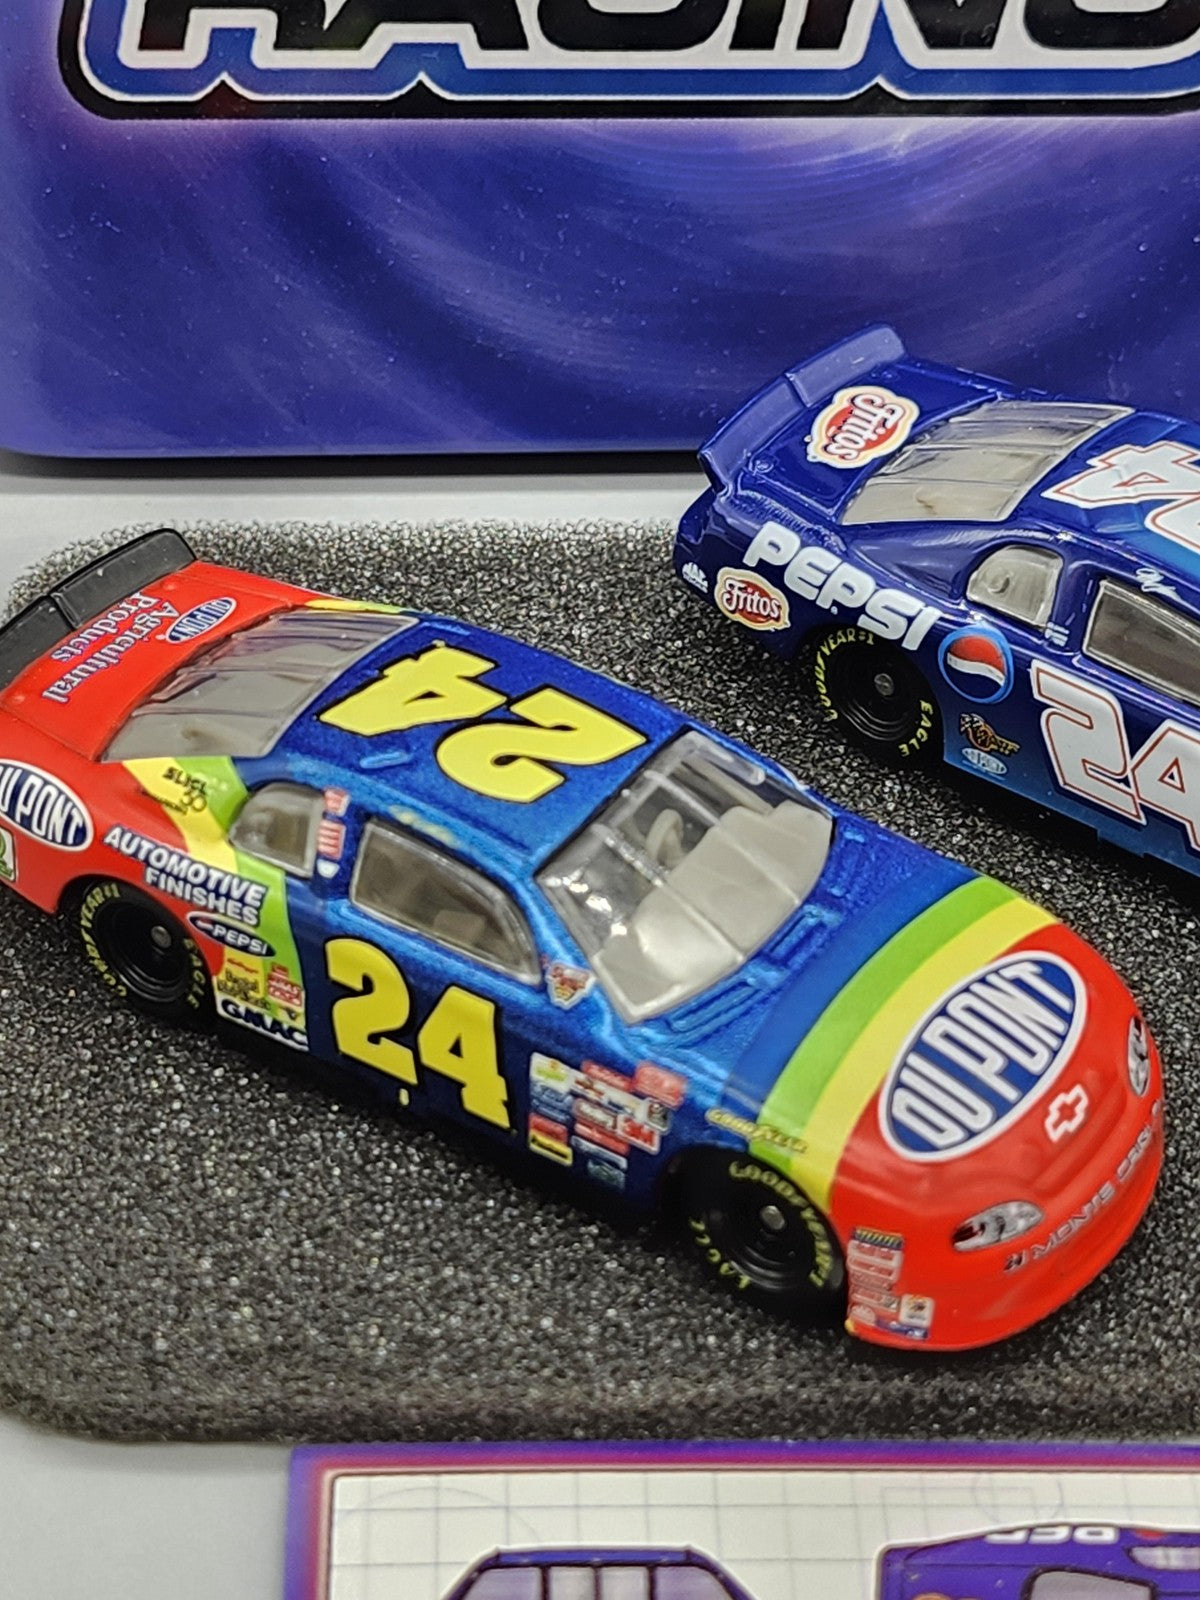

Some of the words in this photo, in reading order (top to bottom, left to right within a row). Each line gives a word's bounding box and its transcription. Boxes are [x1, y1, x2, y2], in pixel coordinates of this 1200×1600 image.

[824, 394, 905, 460] Fritos
[722, 577, 782, 619] Fritos
[743, 521, 943, 651] PEPSI
[42, 601, 180, 703] Agricultural
[51, 591, 161, 662] Products
[317, 644, 648, 803] 24
[898, 700, 933, 757] EAGLE
[1029, 659, 1200, 853] 24
[103, 827, 268, 907] AUTOMOTIVE
[145, 869, 259, 925] FINISHES
[212, 924, 268, 955] PEPSI
[324, 937, 511, 1129] 24
[1030, 1180, 1116, 1260] MONTE
